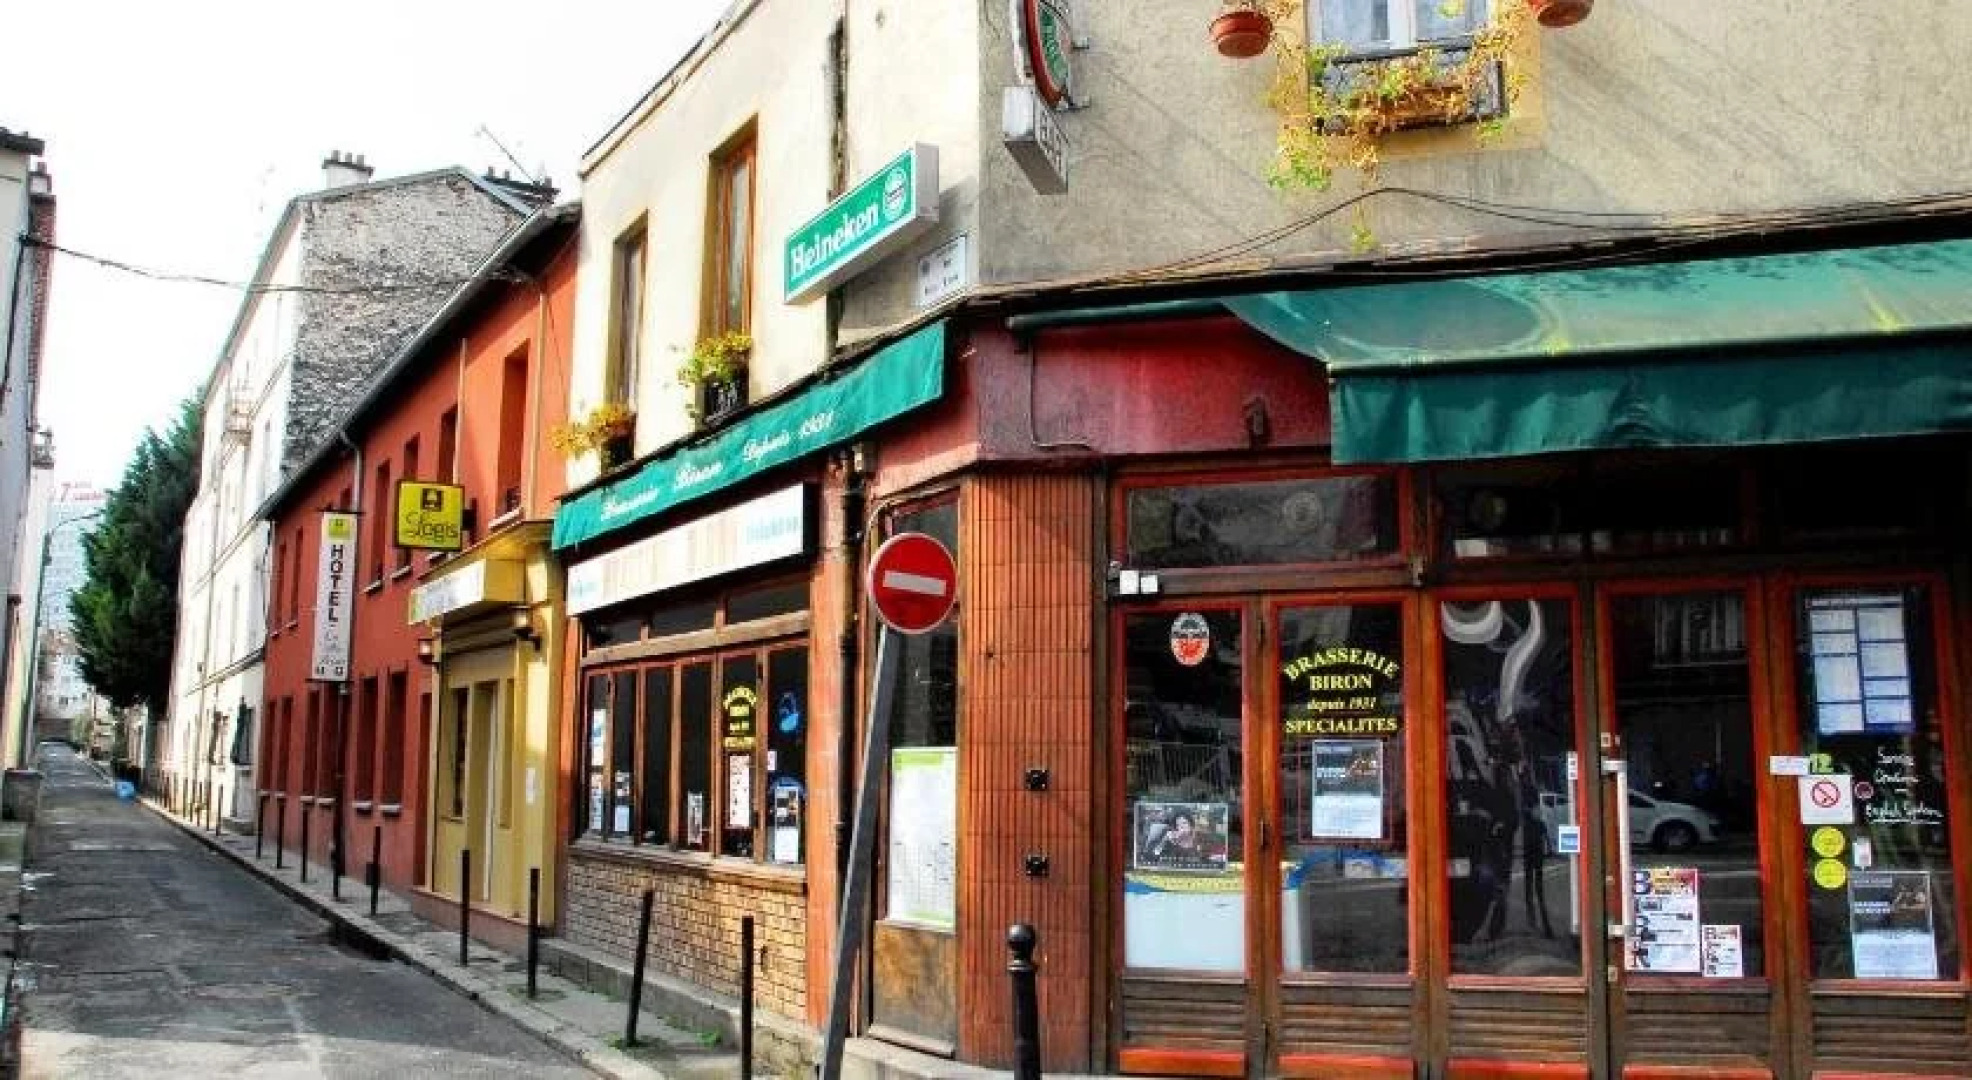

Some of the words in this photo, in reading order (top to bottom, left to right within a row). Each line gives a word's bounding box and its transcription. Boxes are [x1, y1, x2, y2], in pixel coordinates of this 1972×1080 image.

[791, 203, 879, 281] Heineken
[1284, 648, 1399, 681] BRASSERIE
[1309, 674, 1372, 690] BIRON
[1307, 697, 1345, 712] depuis
[1285, 718, 1398, 733] SPECIALITES
